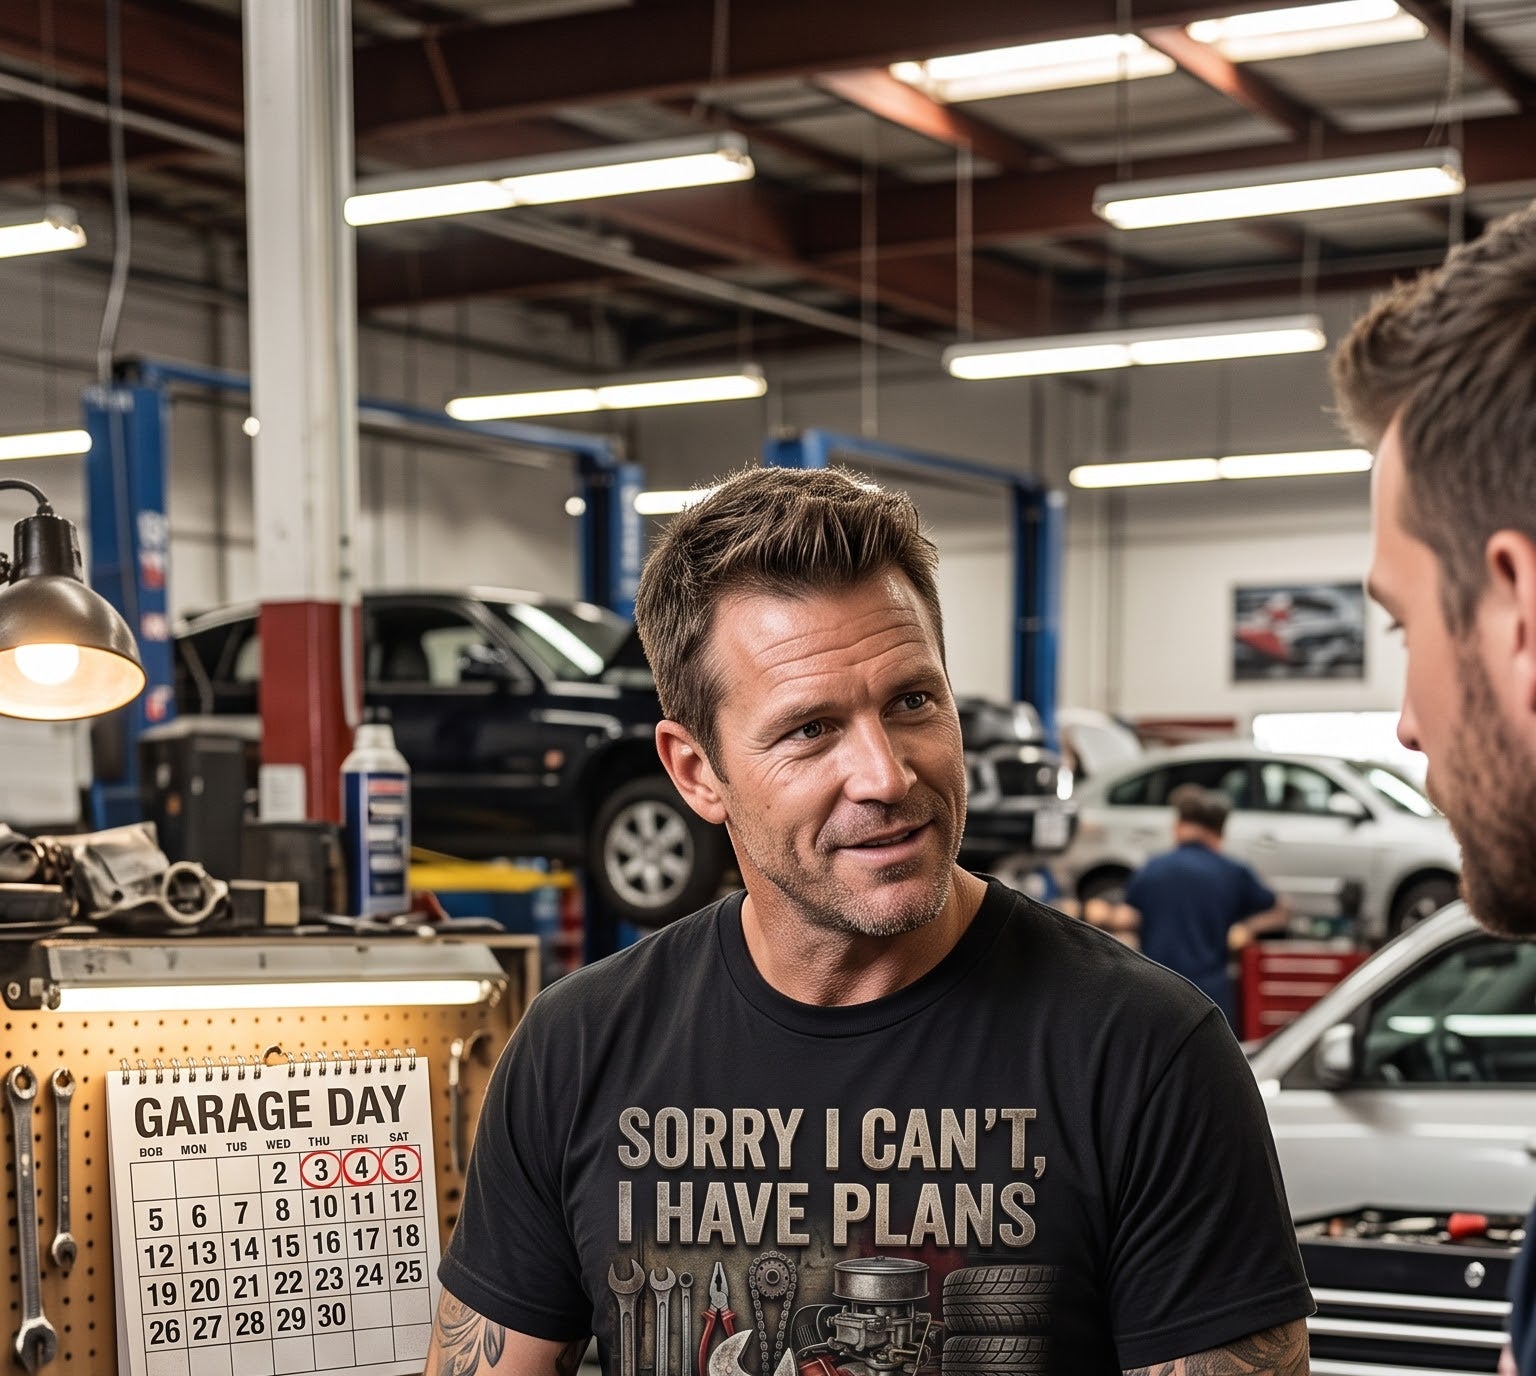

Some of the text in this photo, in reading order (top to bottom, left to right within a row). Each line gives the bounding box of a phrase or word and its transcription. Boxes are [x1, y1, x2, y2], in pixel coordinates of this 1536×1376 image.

[134, 1084, 407, 1139] GARAGE DAY
[180, 1143, 207, 1155] MON
[265, 1138, 291, 1150] WED
[307, 1136, 330, 1147] THU
[351, 1133, 369, 1145] FRI
[389, 1131, 409, 1143] SAT
[618, 1107, 1046, 1179] SORRY I CAN'T,
[272, 1153, 408, 1185] 2 3 4 5
[149, 1188, 418, 1232] 5 6 7 8 10 11 12
[618, 1180, 1036, 1248] I HAVE PLANS
[144, 1223, 420, 1269] 12 13 14 15 16 17 18
[146, 1259, 423, 1307] 19 20 21 22 23 24 25
[149, 1302, 346, 1346] 26 27 28 29 30
